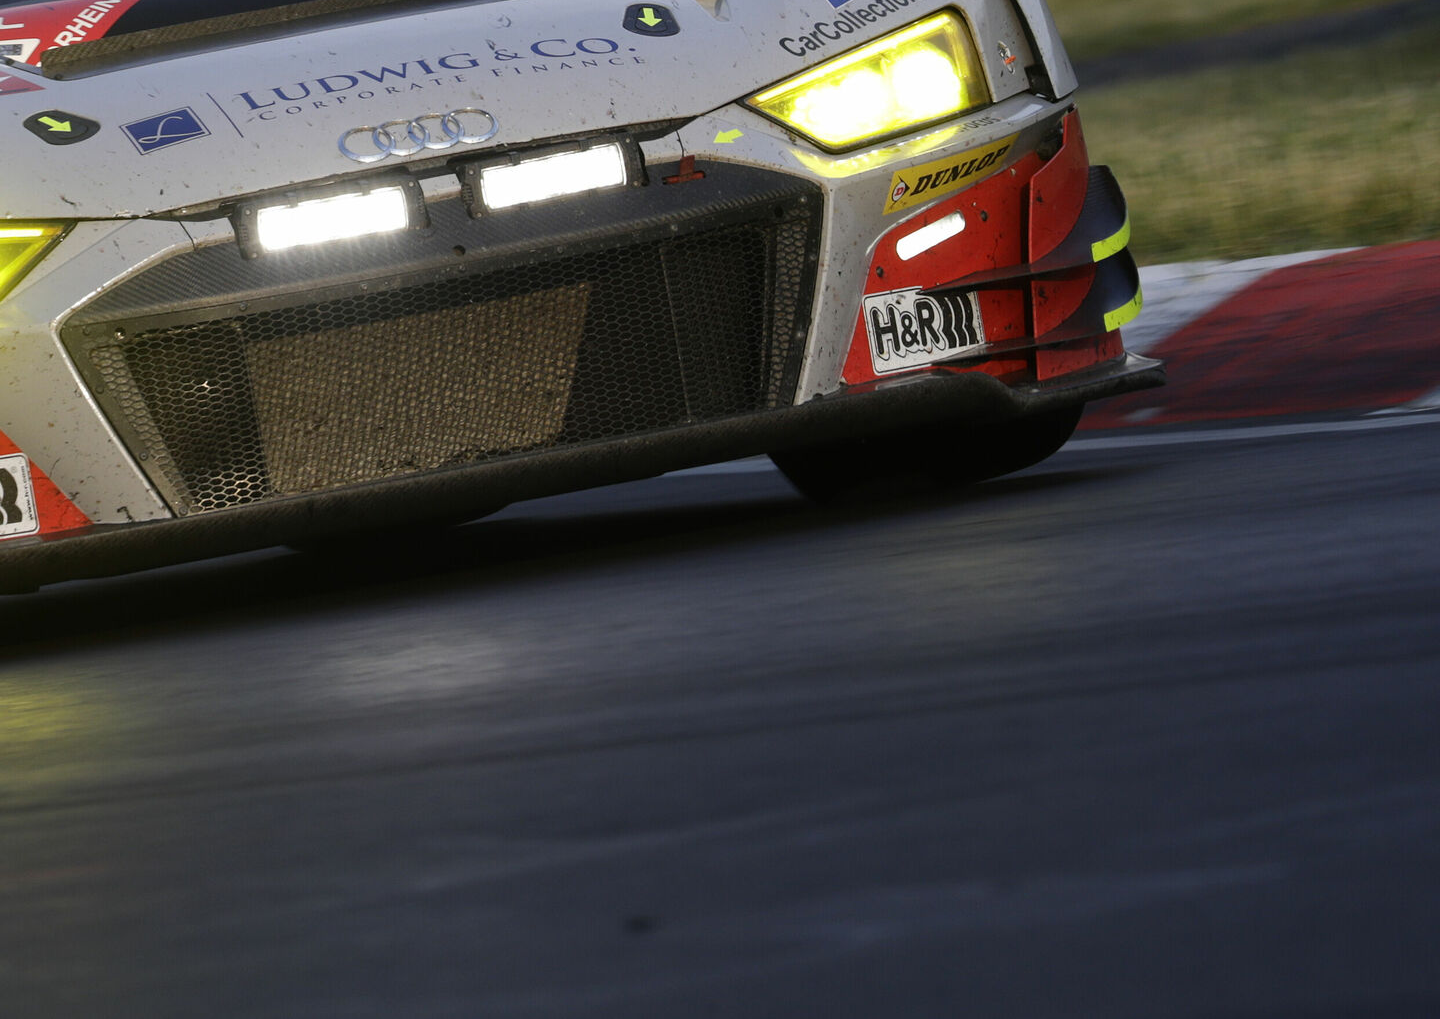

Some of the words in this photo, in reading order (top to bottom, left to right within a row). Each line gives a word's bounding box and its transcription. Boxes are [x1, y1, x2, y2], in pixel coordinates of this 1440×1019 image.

[238, 52, 481, 110] LUDWIG
[258, 74, 468, 121] CORPORATE
[491, 55, 647, 77] FINANCE
[910, 144, 1010, 197] DUNLOP
[871, 300, 940, 355] H&R
